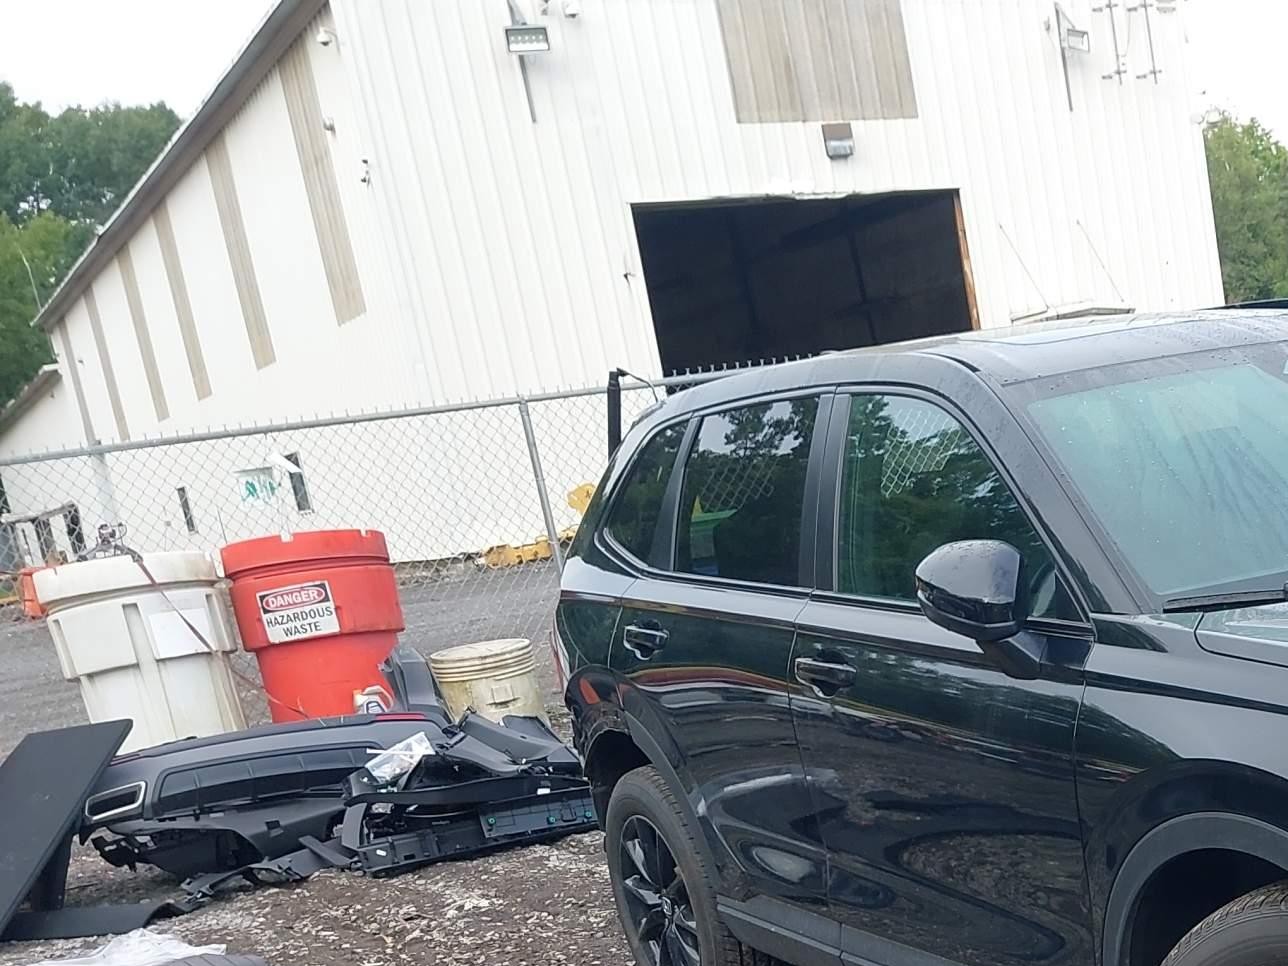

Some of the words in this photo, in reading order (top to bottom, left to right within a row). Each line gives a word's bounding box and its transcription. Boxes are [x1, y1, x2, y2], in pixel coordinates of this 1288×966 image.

[268, 589, 318, 608] DANGER
[266, 606, 333, 629] HAZARDOUS
[282, 621, 322, 637] WASTE
